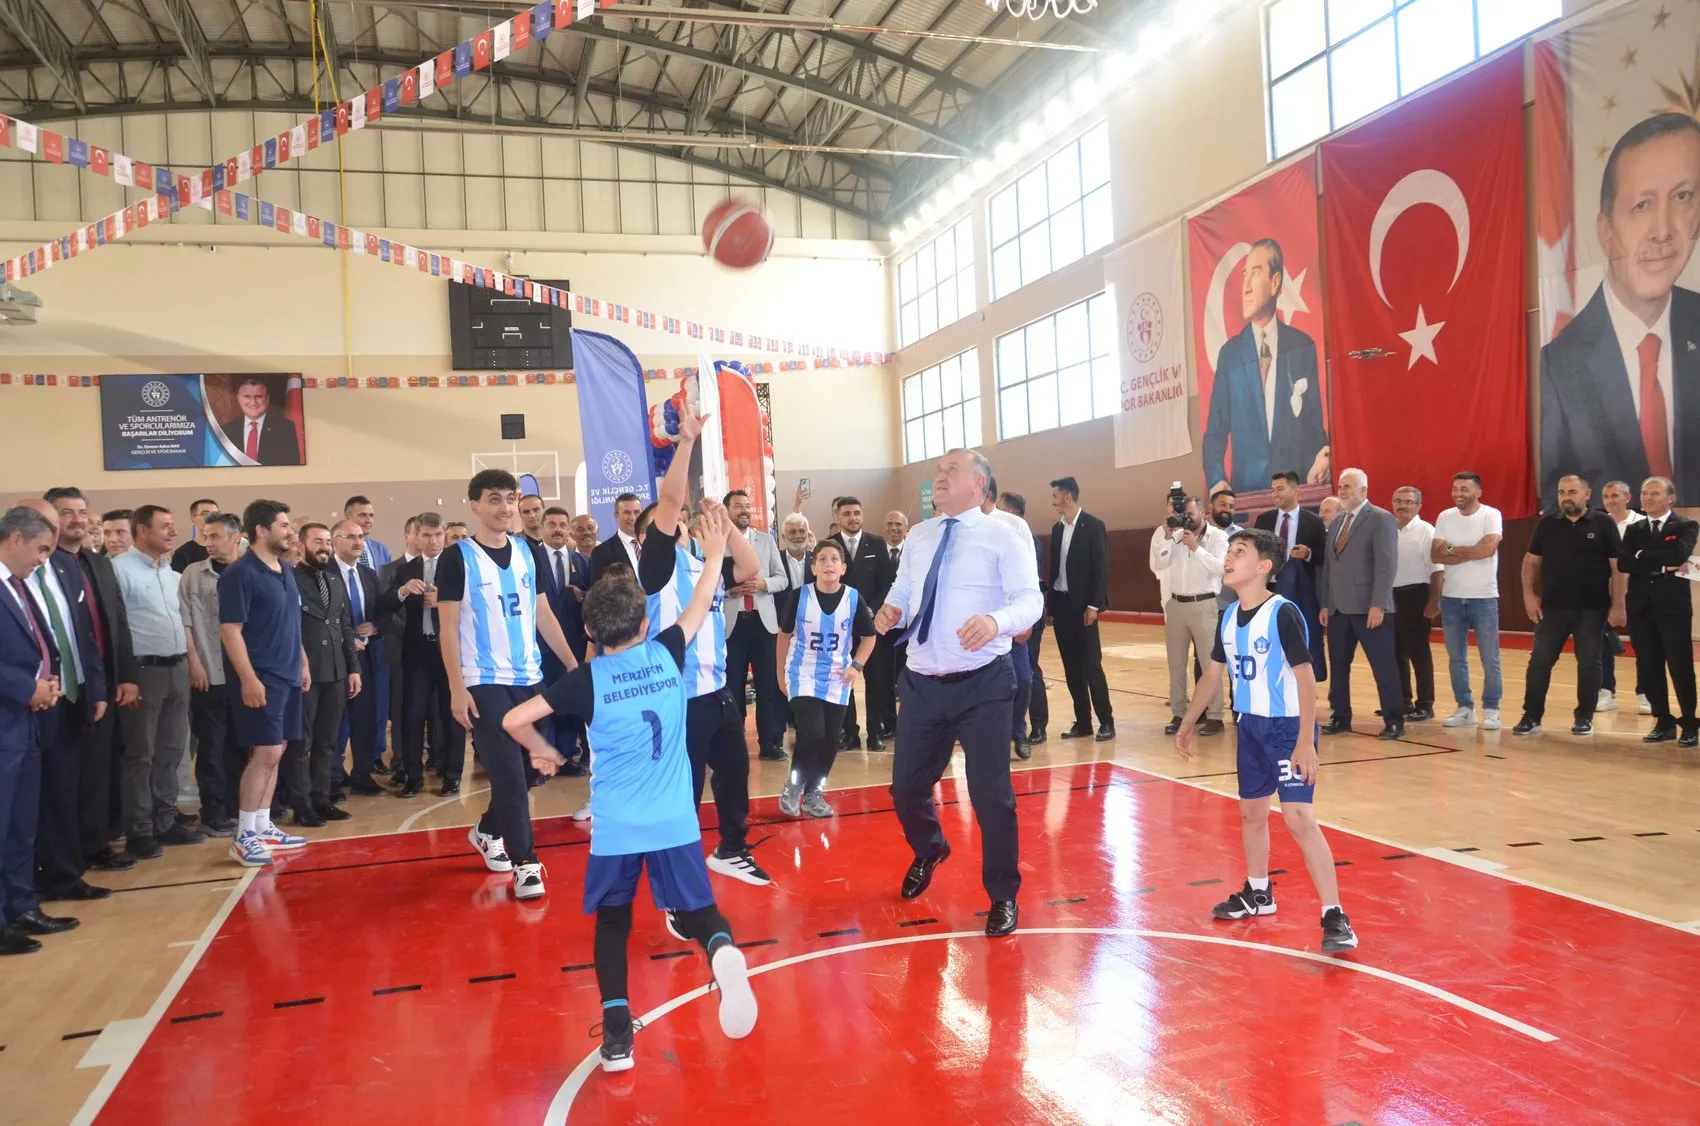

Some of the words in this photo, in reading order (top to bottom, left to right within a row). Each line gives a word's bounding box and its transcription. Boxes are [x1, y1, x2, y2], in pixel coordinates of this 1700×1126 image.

[1131, 366, 1169, 390] GENÇLİK
[127, 415, 145, 423] TÜM
[146, 414, 187, 423] ANTRENÖR
[497, 593, 522, 618] 12
[810, 631, 840, 652] 23
[611, 663, 664, 684] MERZİFON
[603, 677, 679, 704] BELEDİYESPOR
[641, 710, 662, 760] 1
